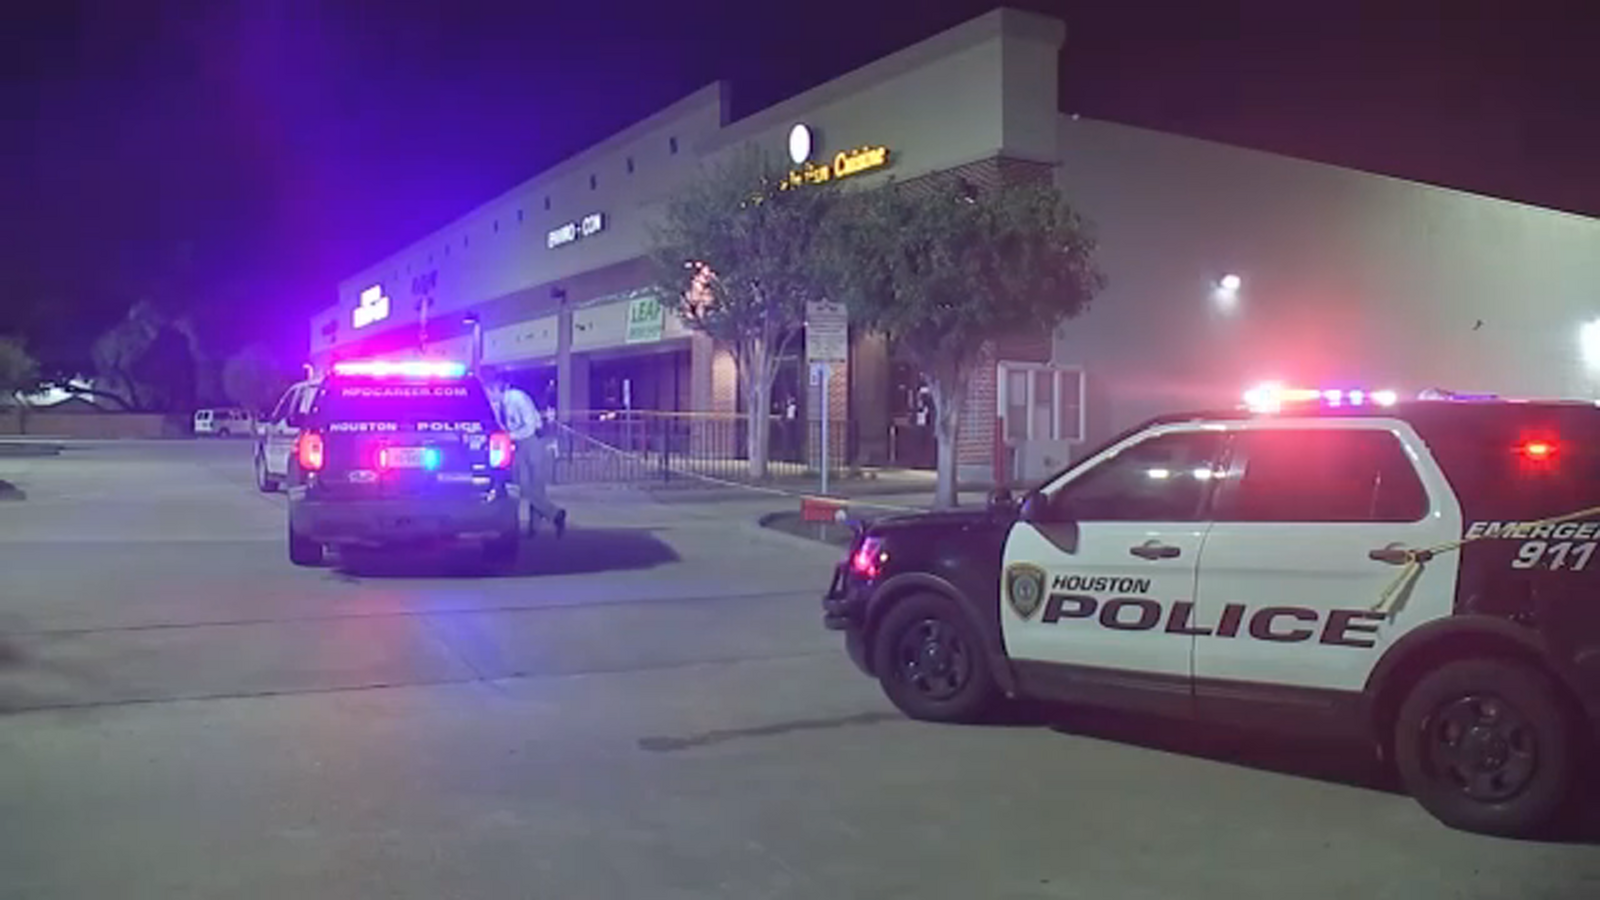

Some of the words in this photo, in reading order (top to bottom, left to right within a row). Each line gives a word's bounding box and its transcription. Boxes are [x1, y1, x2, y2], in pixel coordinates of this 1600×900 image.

[834, 146, 886, 178] Cuisine
[329, 422, 398, 432] HOUSTON
[416, 421, 483, 432] POLICE
[1511, 541, 1598, 571] 911
[1052, 575, 1152, 594] HOUSTON
[1041, 593, 1387, 649] POLICE
